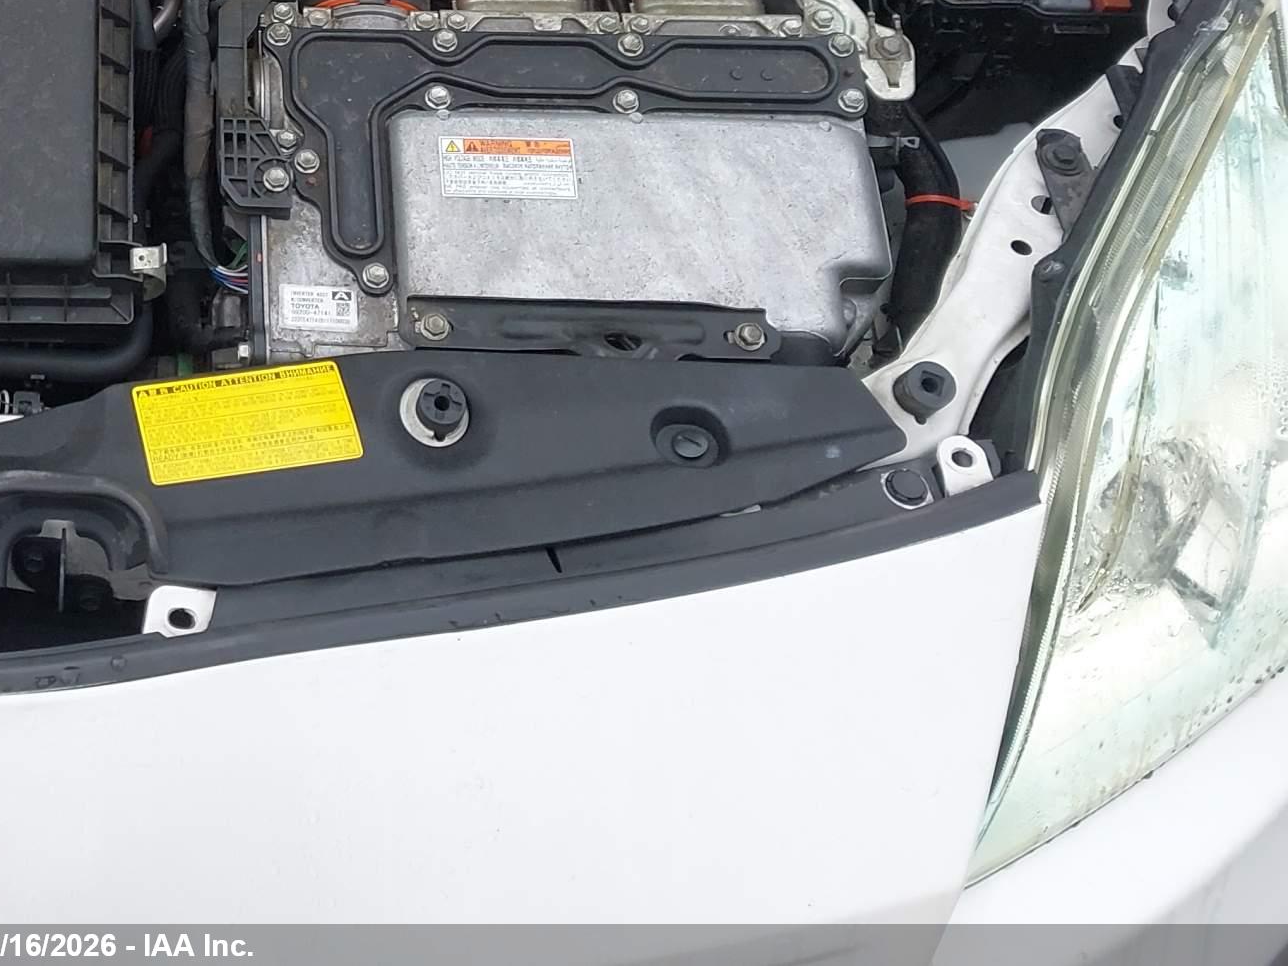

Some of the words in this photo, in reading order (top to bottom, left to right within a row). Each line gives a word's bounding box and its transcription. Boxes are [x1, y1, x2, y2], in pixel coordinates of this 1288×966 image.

[173, 382, 216, 394] CAUTION
[220, 373, 277, 387] ATTENTION
[280, 364, 334, 380] ВНИМАНИЕ
